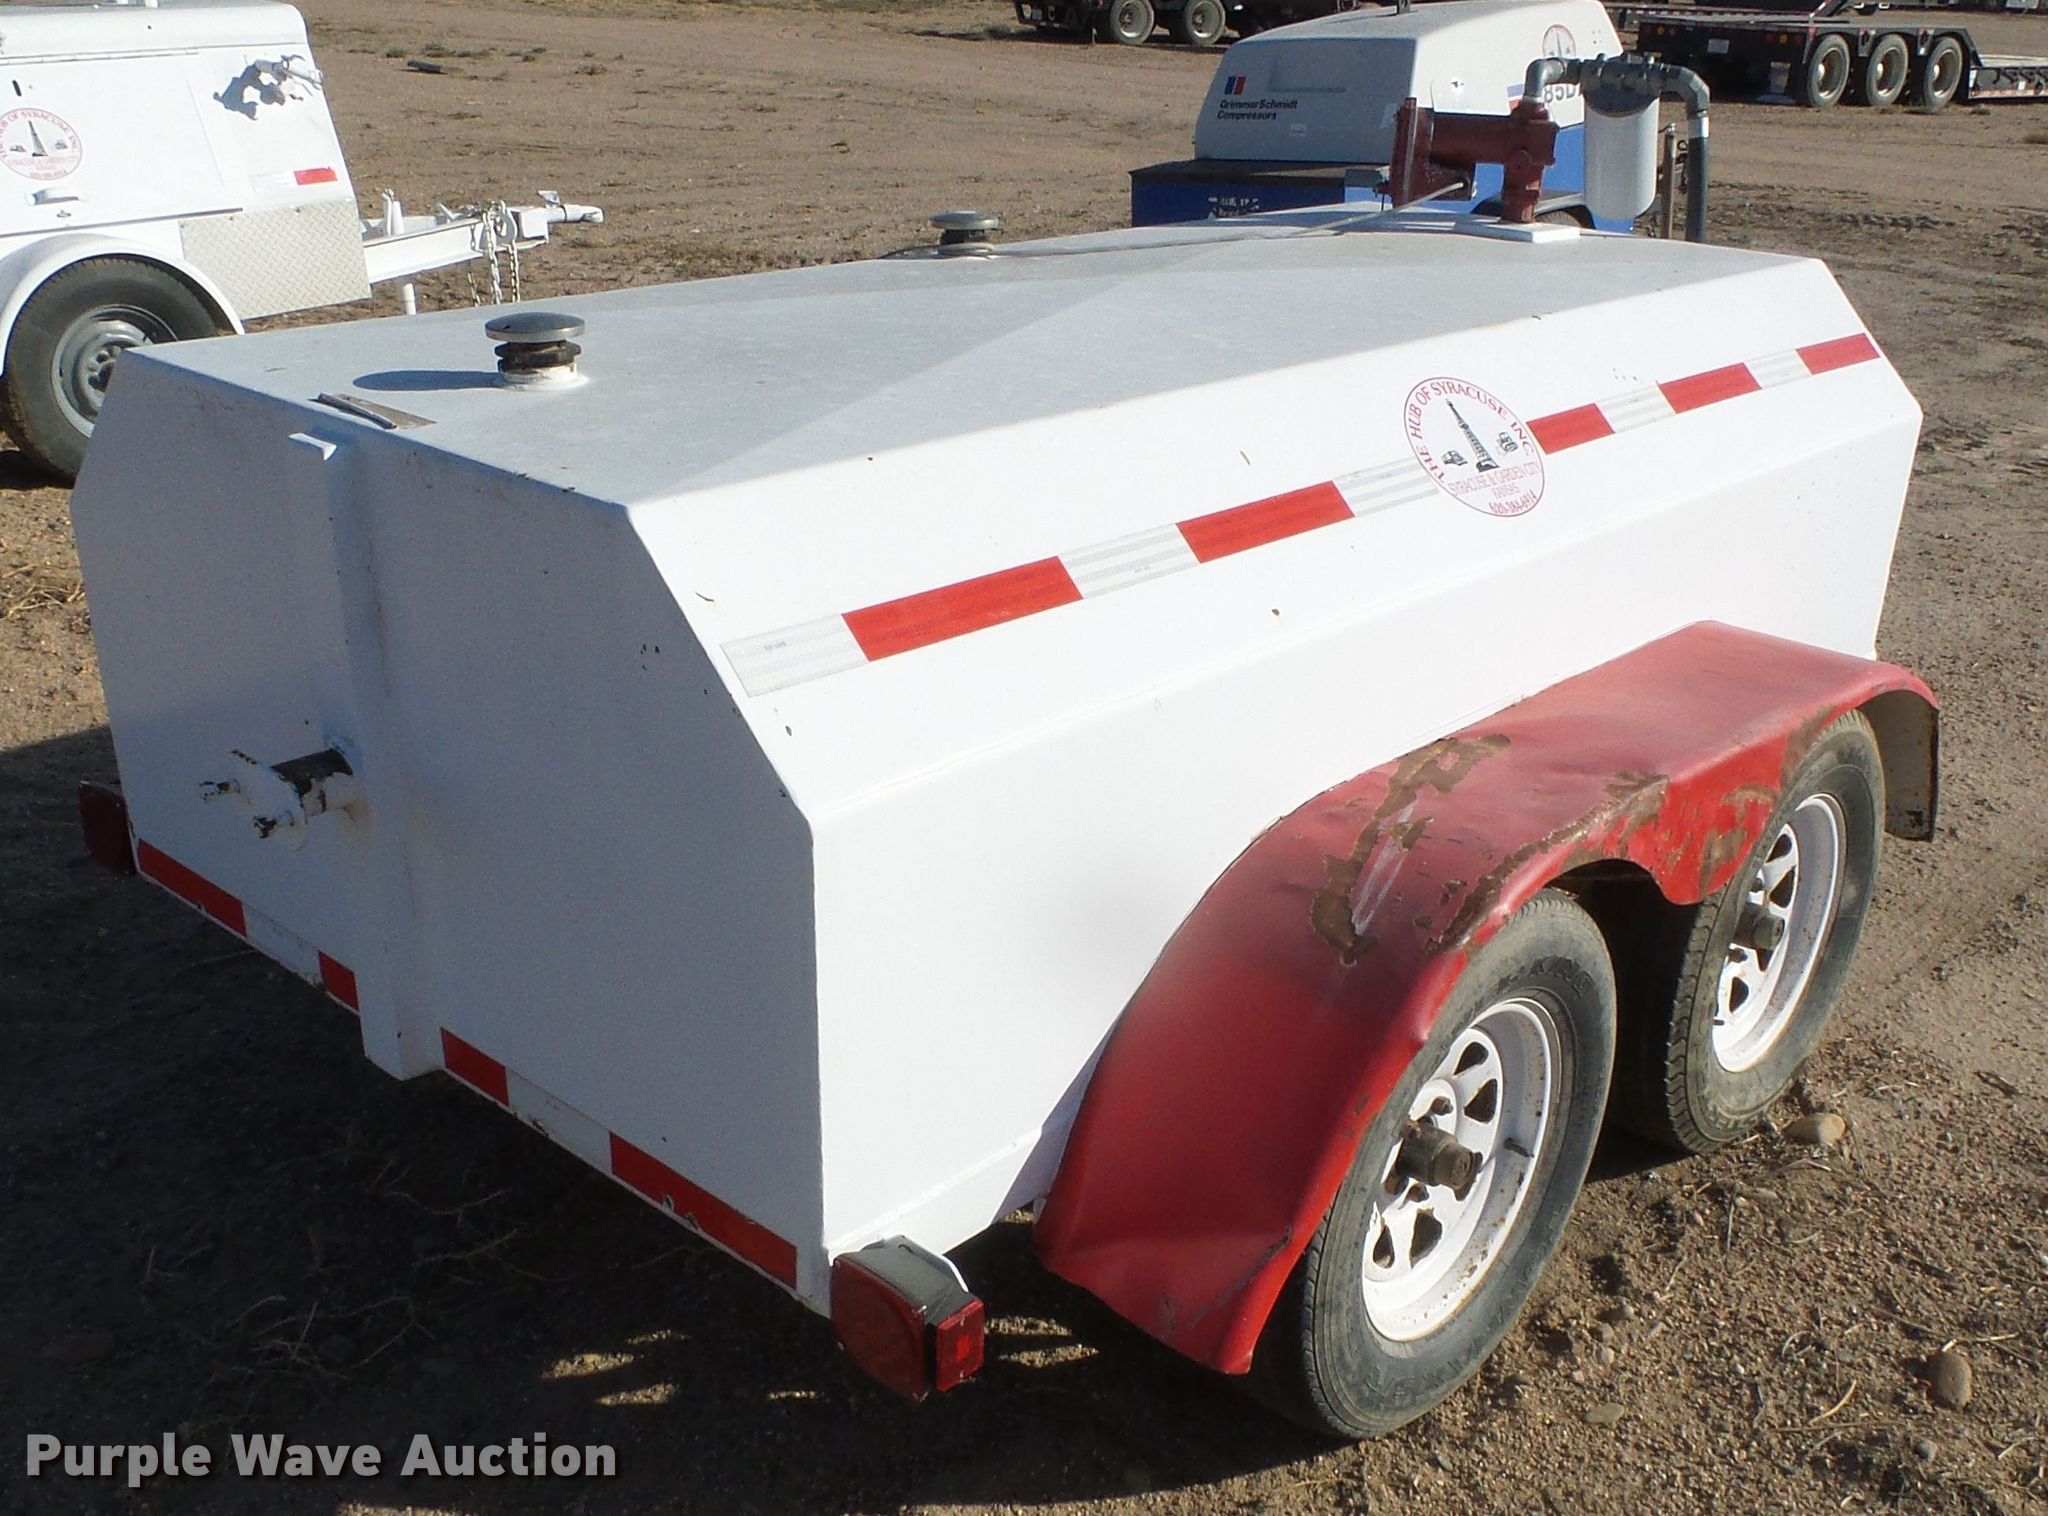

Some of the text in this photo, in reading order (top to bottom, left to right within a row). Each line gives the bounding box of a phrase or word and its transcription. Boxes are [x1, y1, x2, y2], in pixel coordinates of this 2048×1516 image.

[1216, 110, 1278, 121] Compressors
[1415, 385, 1432, 406] OF
[1430, 381, 1508, 420] SYRACUSE
[1408, 404, 1423, 440] HUB
[1416, 444, 1446, 485] THE
